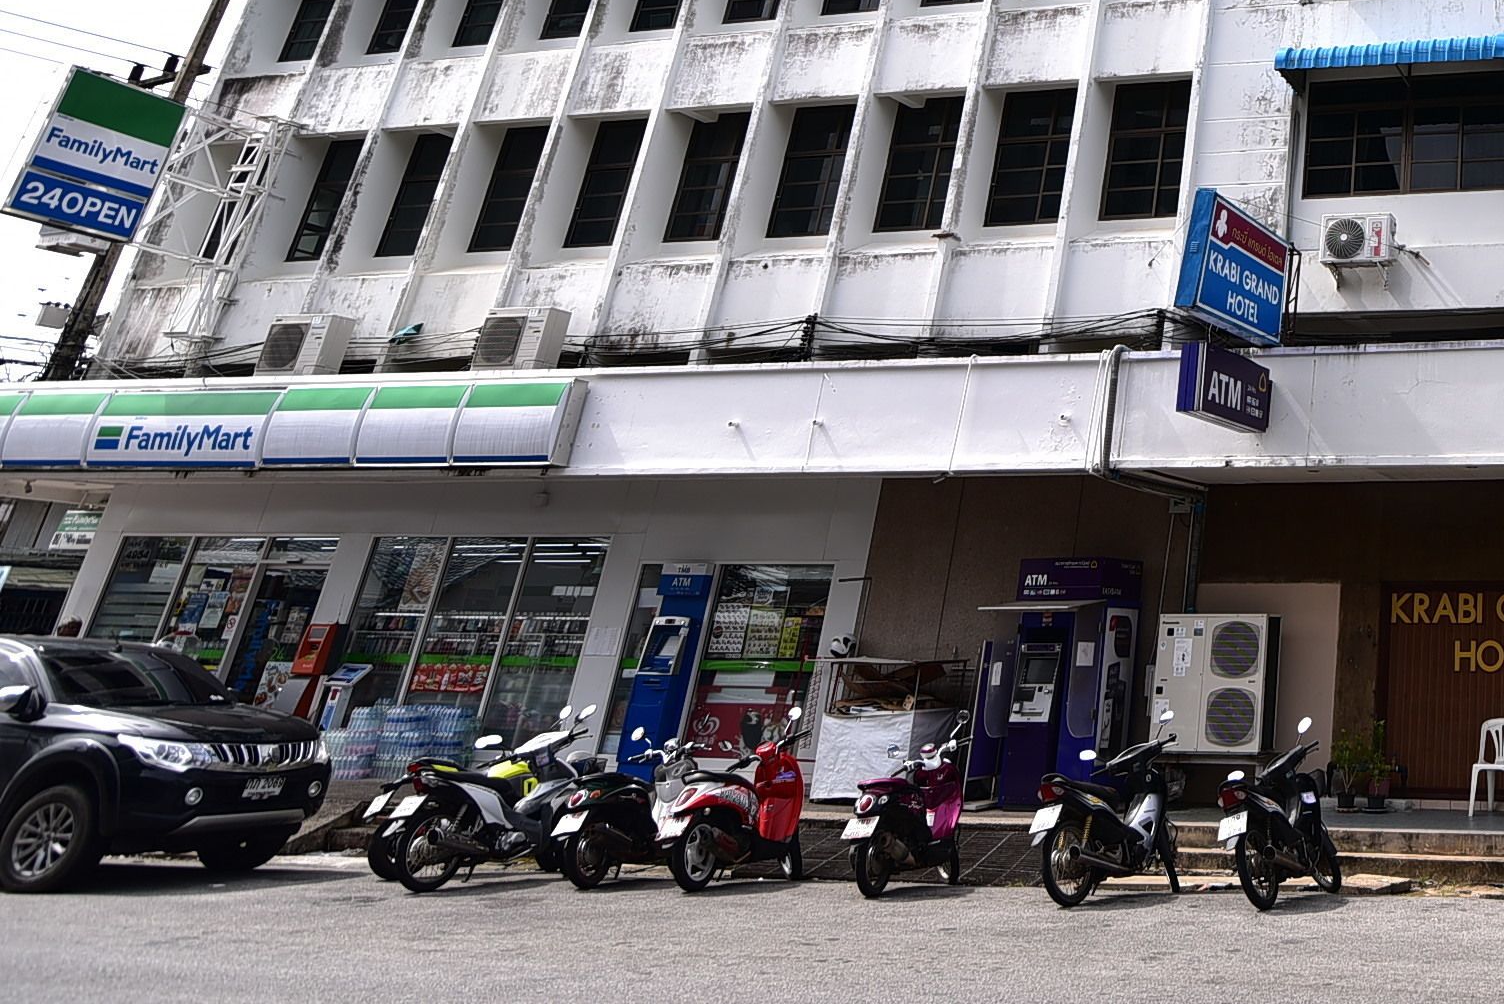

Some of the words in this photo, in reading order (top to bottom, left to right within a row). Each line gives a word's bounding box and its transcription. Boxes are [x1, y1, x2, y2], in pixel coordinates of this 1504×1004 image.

[46, 126, 159, 174] FamilyMart
[1209, 249, 1240, 284] KRABI
[1242, 270, 1279, 305] GRAND
[1226, 290, 1258, 324] HOTEL
[1207, 370, 1242, 411] ATM
[124, 424, 253, 457] FamilyMart
[671, 577, 692, 587] ATM
[1024, 574, 1048, 586] ATM
[1391, 593, 1483, 624] KRABI
